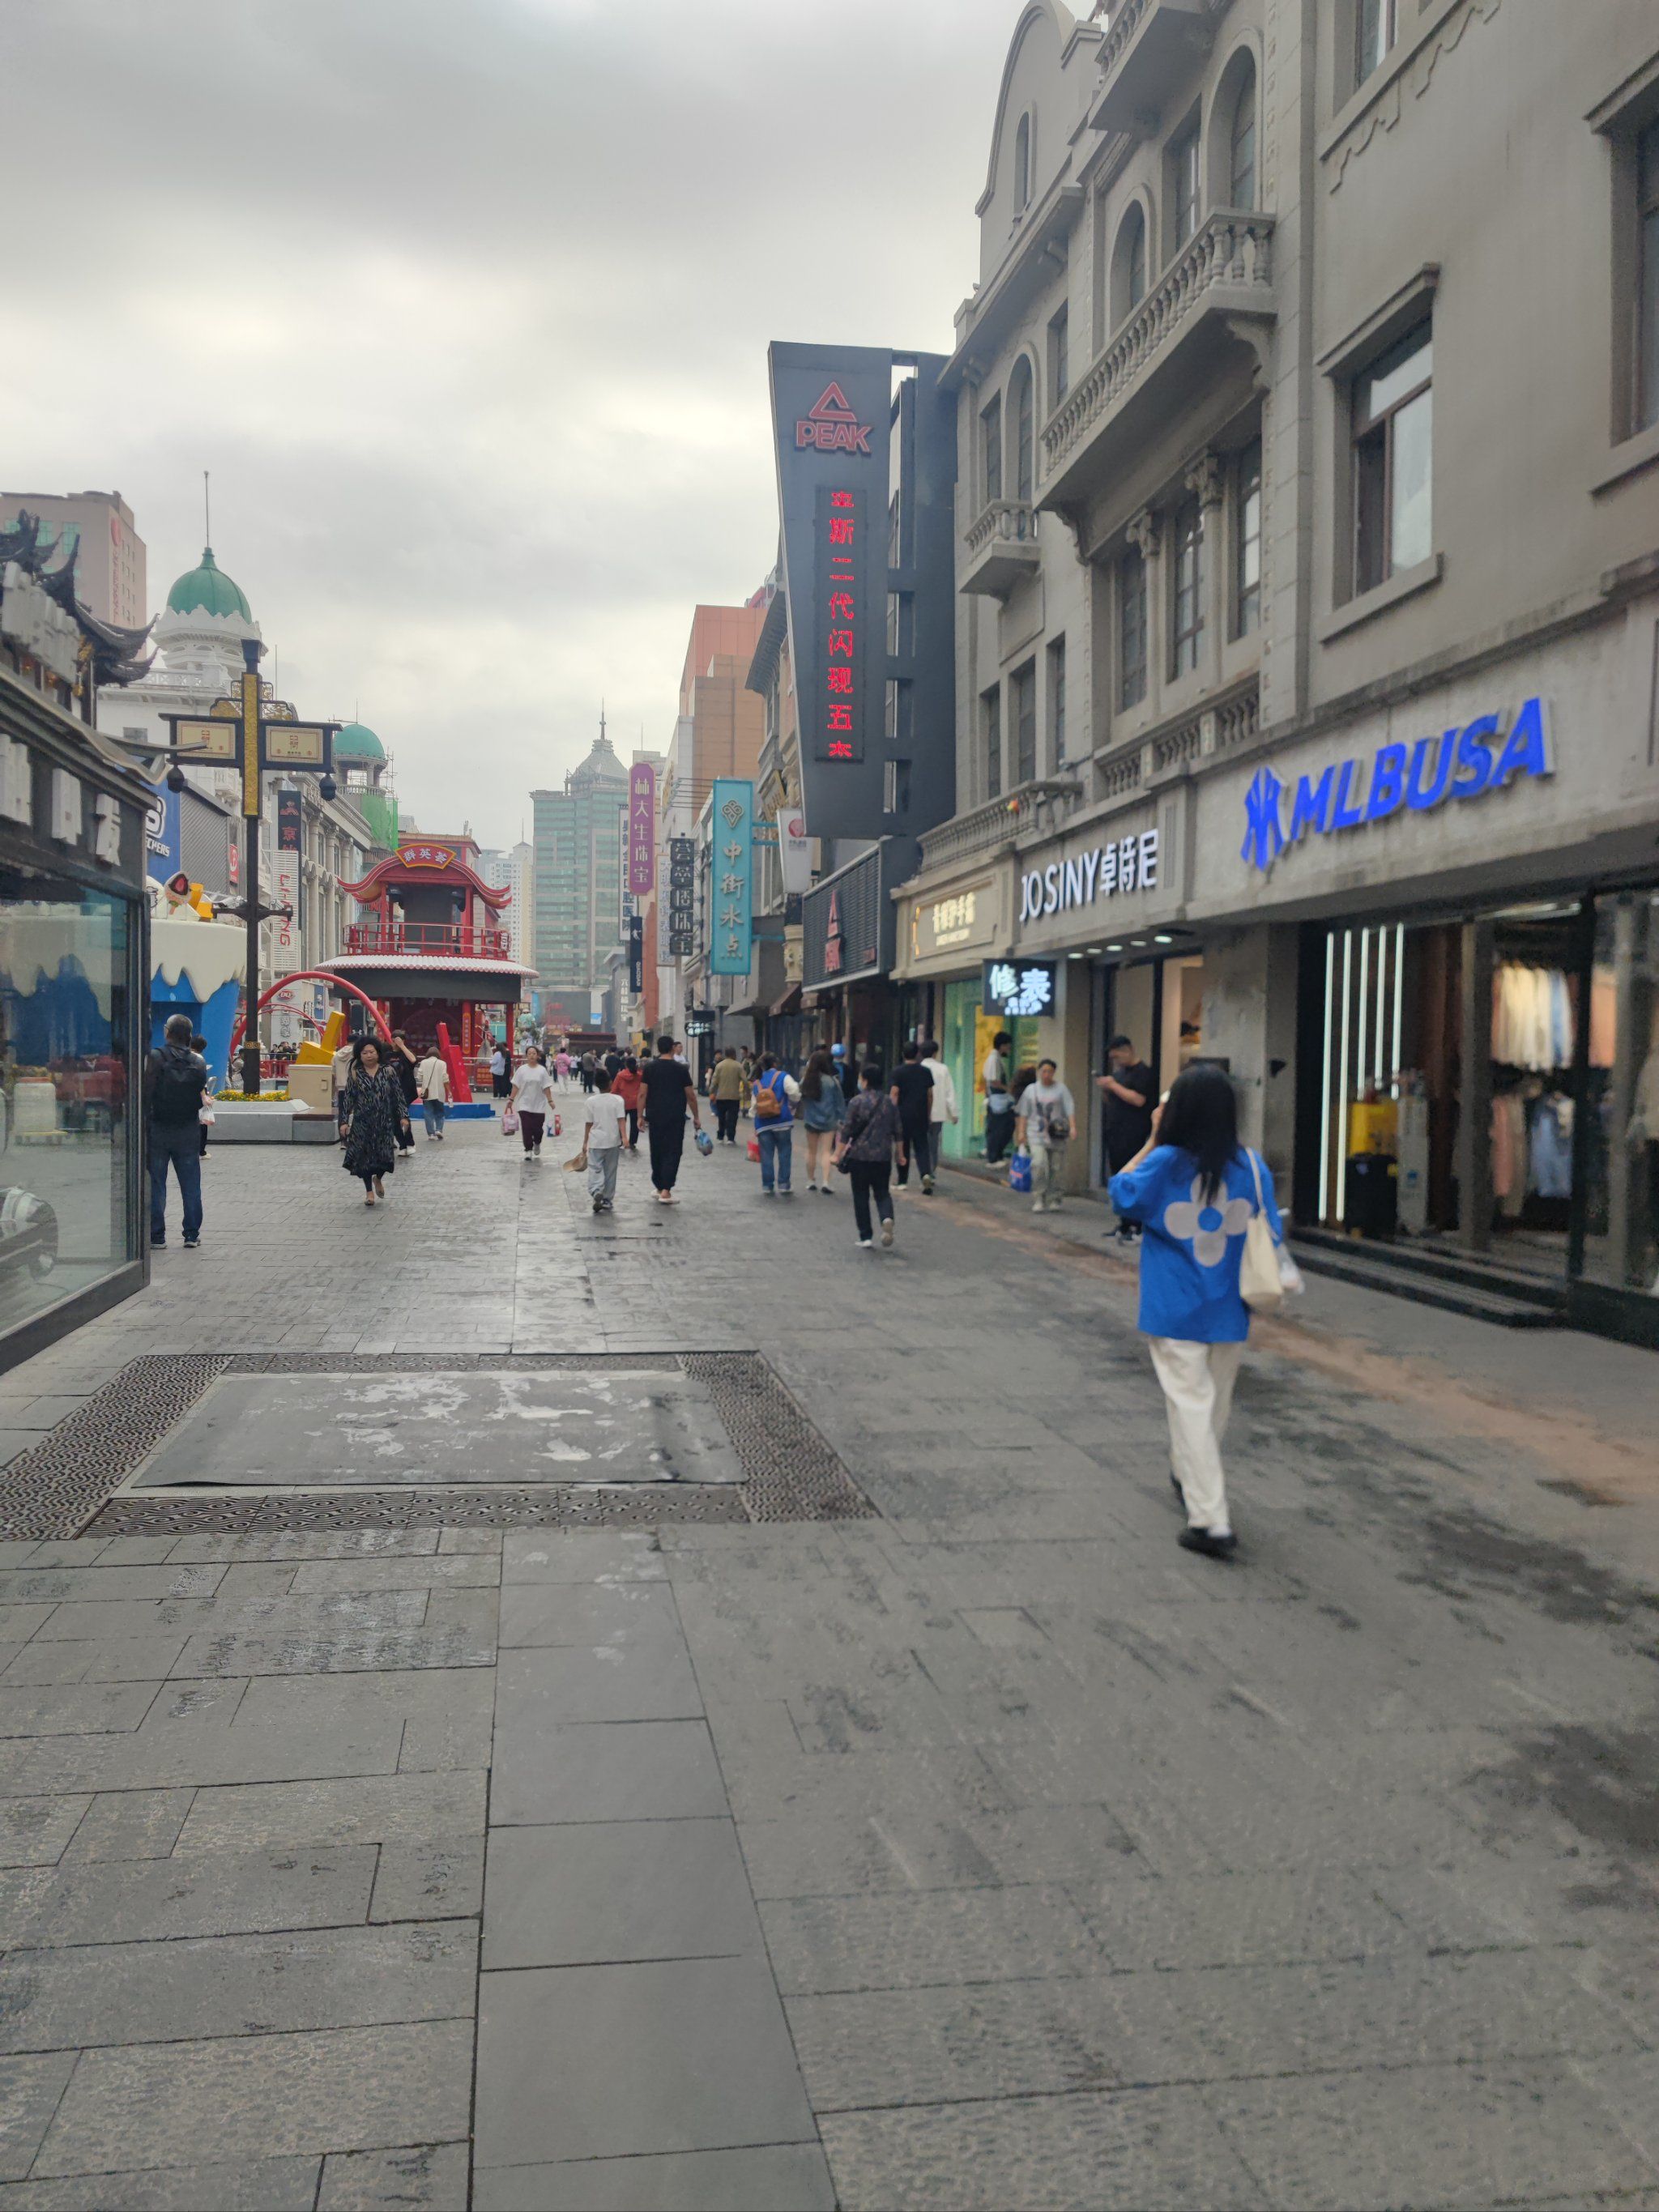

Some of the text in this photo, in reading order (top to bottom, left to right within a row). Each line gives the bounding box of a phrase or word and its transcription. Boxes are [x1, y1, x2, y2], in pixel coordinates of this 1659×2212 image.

[796, 420, 872, 453] PEAK
[1019, 847, 1101, 923] JOSINY
[989, 964, 1051, 1003] 修表
